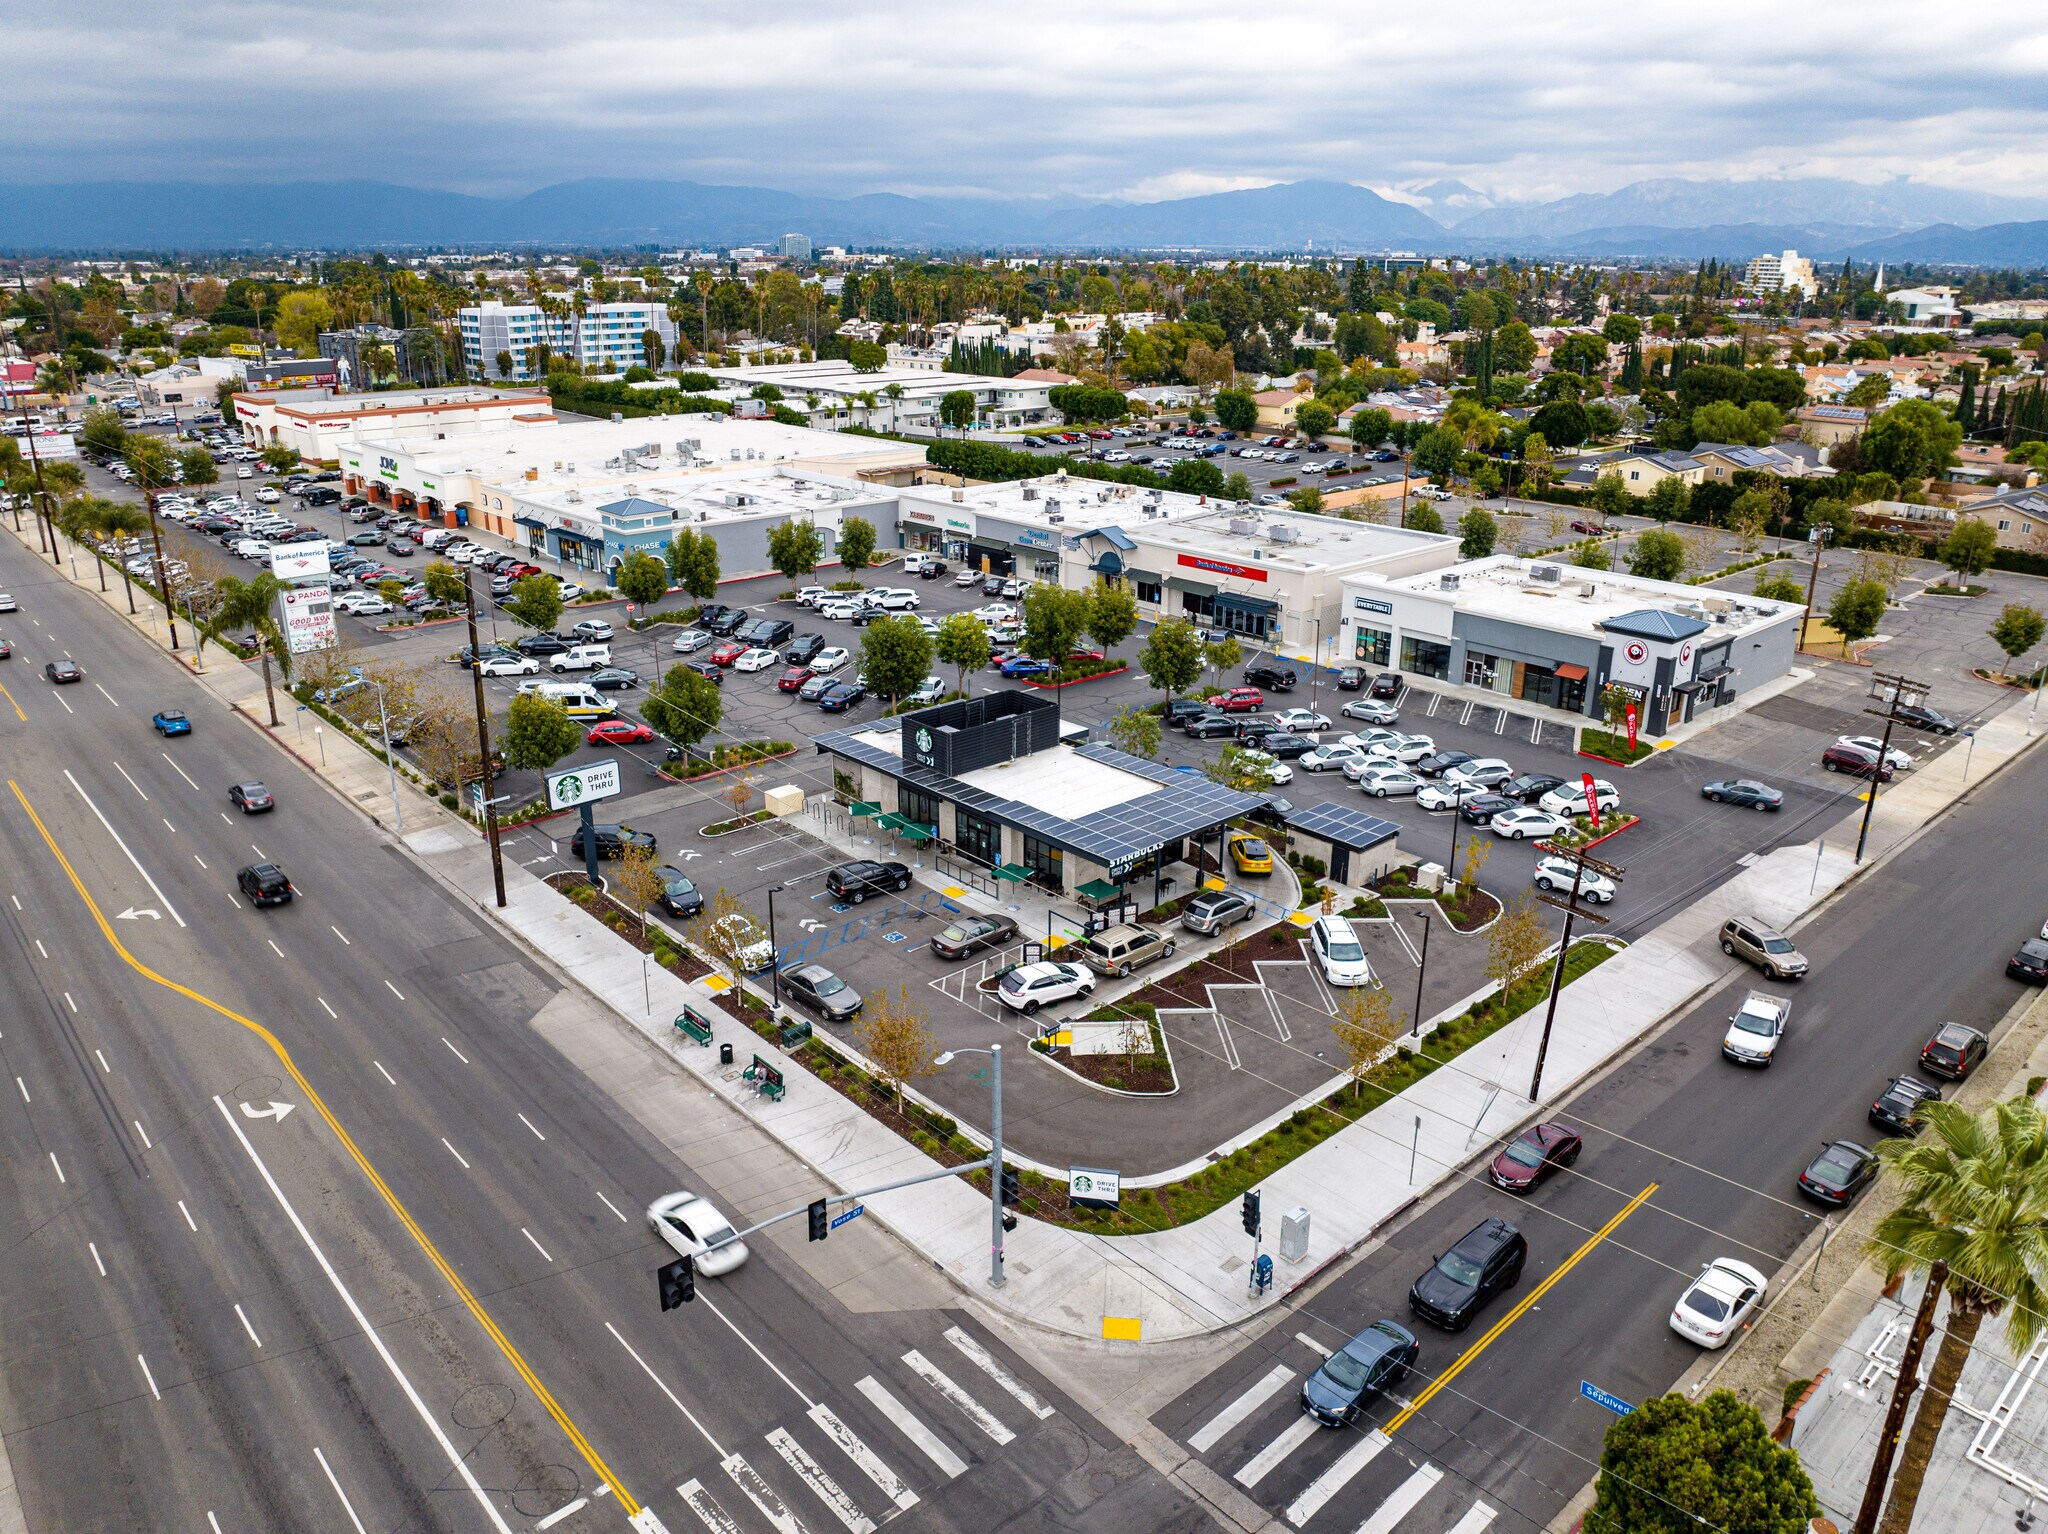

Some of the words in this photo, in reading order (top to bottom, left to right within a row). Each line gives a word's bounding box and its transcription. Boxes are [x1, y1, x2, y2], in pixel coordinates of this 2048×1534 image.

[379, 456, 394, 470] JONS
[1028, 529, 1049, 540] Dental
[605, 540, 620, 549] CHASE
[634, 541, 660, 551] CHASE
[1018, 535, 1033, 544] Care
[1033, 539, 1053, 549] Center
[299, 550, 325, 558] America
[298, 590, 329, 600] PANDA
[1357, 601, 1388, 612] EVERYTABLE
[290, 617, 312, 626] GOOD
[587, 770, 614, 783] DRIVE
[590, 780, 614, 792] THRU
[1109, 842, 1165, 868] STARBUCKS
[834, 1214, 851, 1226] Vose
[852, 1208, 861, 1217] St
[1586, 1386, 1631, 1415] Sepulved
